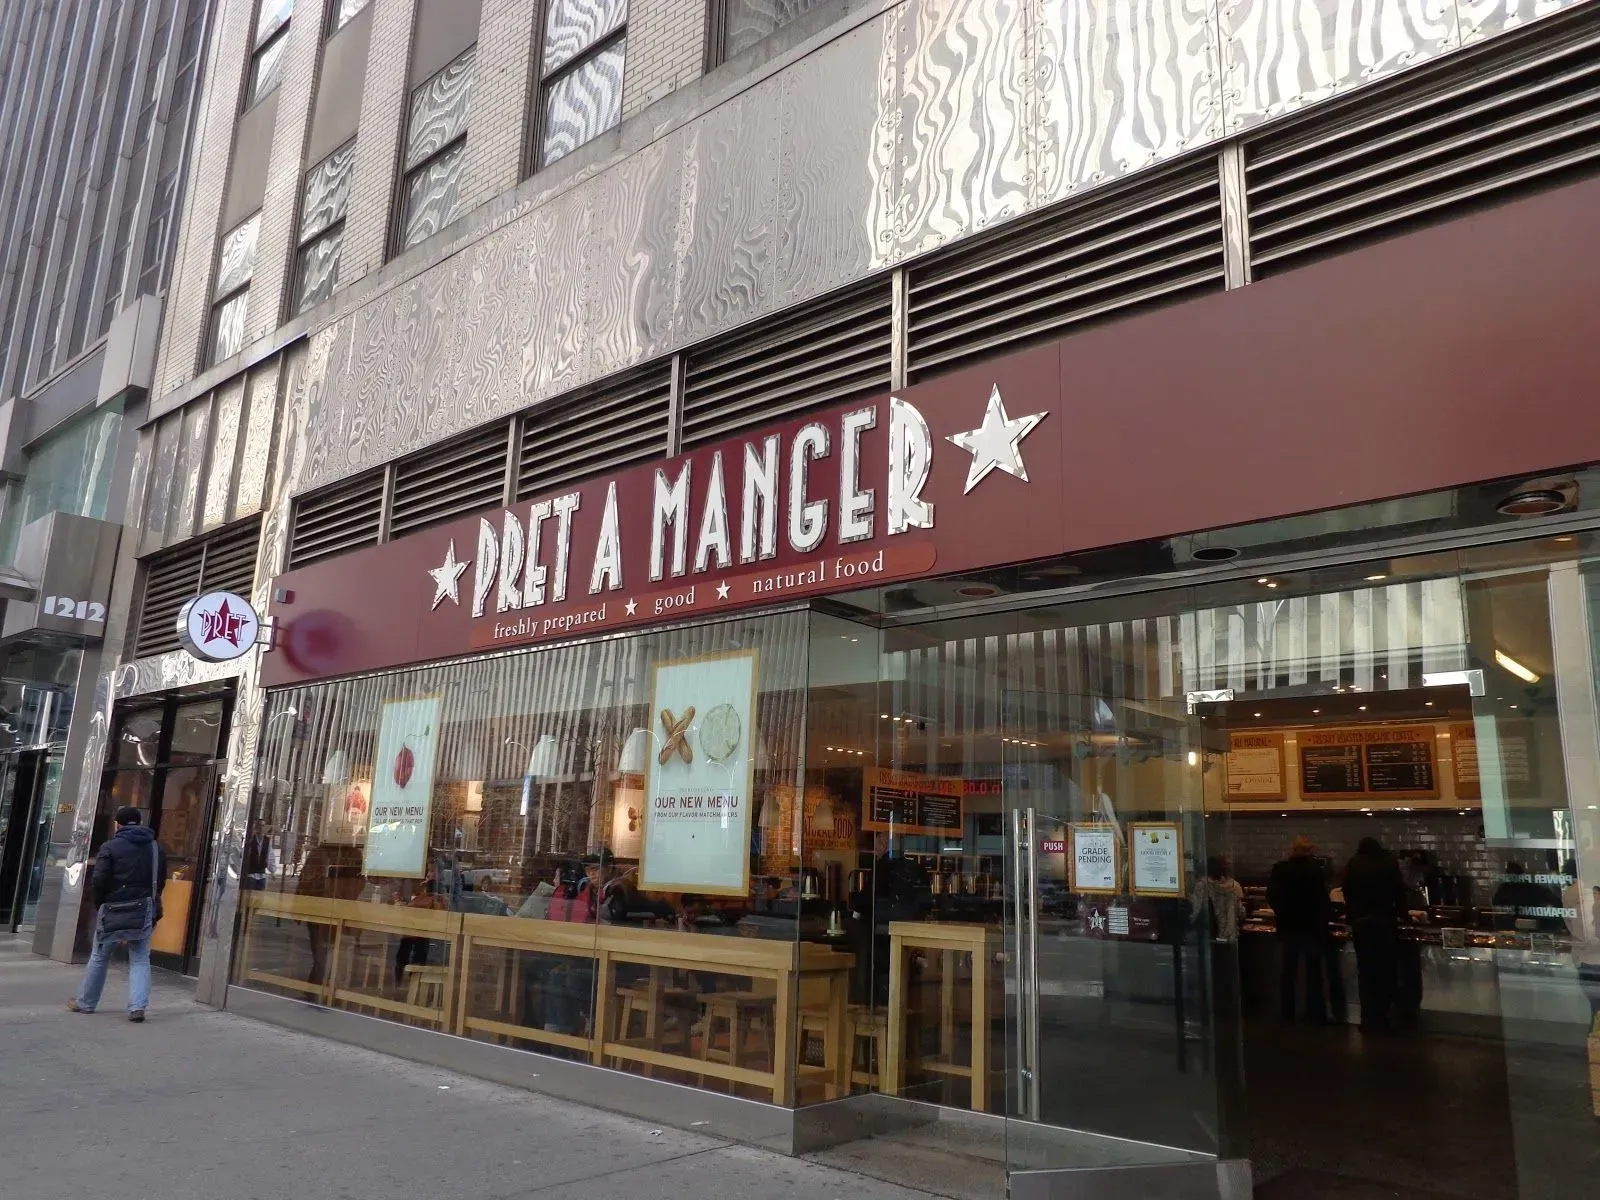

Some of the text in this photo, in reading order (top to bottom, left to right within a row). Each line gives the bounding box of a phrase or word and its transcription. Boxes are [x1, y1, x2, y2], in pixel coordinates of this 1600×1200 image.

[472, 396, 935, 618] PRET A MANGER
[494, 550, 884, 639] freshly prepared good natural food
[44, 595, 105, 622] 1212
[200, 608, 247, 640] PRET
[655, 796, 739, 809] OUR NEW MENU
[375, 806, 424, 816] OUR NEW MENU
[1043, 842, 1064, 851] PUSH
[1081, 847, 1107, 855] GRADE
[1078, 855, 1112, 863] PENDING
